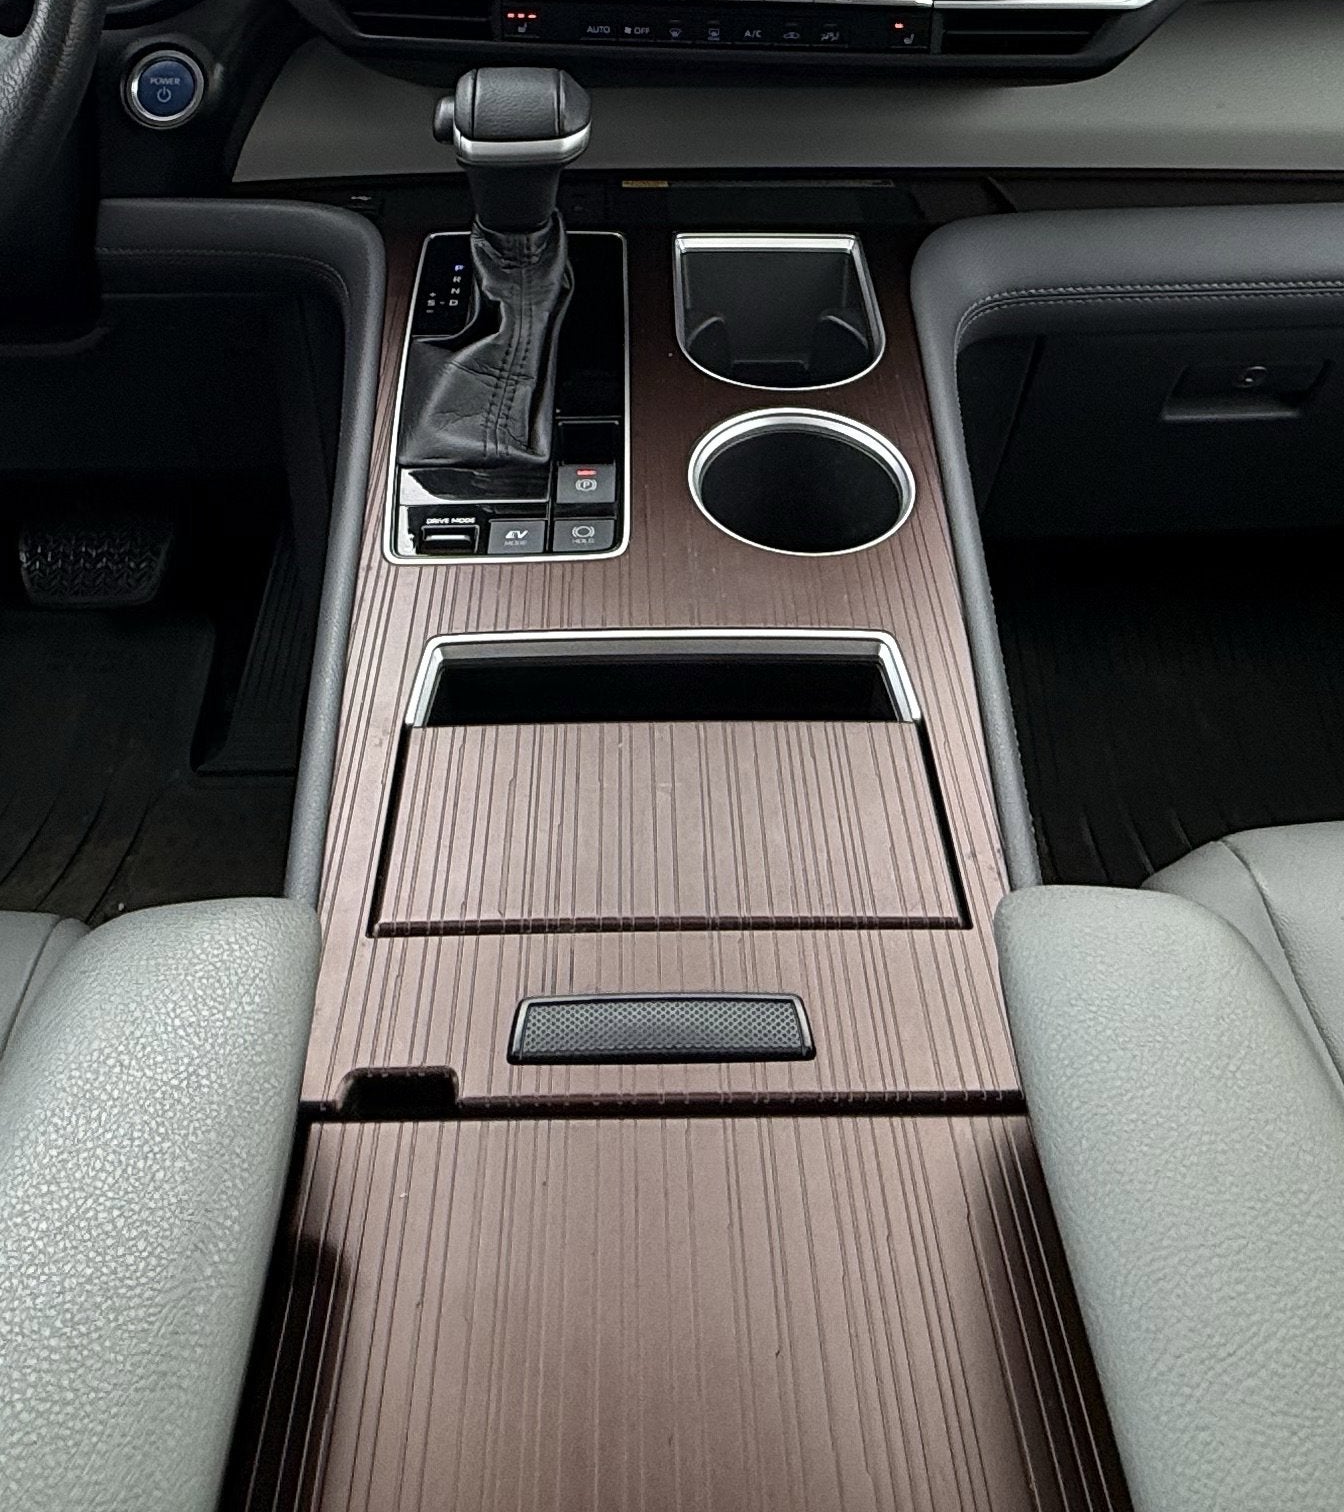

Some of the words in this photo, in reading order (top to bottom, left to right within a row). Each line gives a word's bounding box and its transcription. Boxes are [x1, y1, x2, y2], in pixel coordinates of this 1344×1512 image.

[586, 25, 611, 34] AUTO
[634, 27, 650, 35] OFF
[744, 29, 762, 38] A/C
[149, 77, 181, 86] POWER
